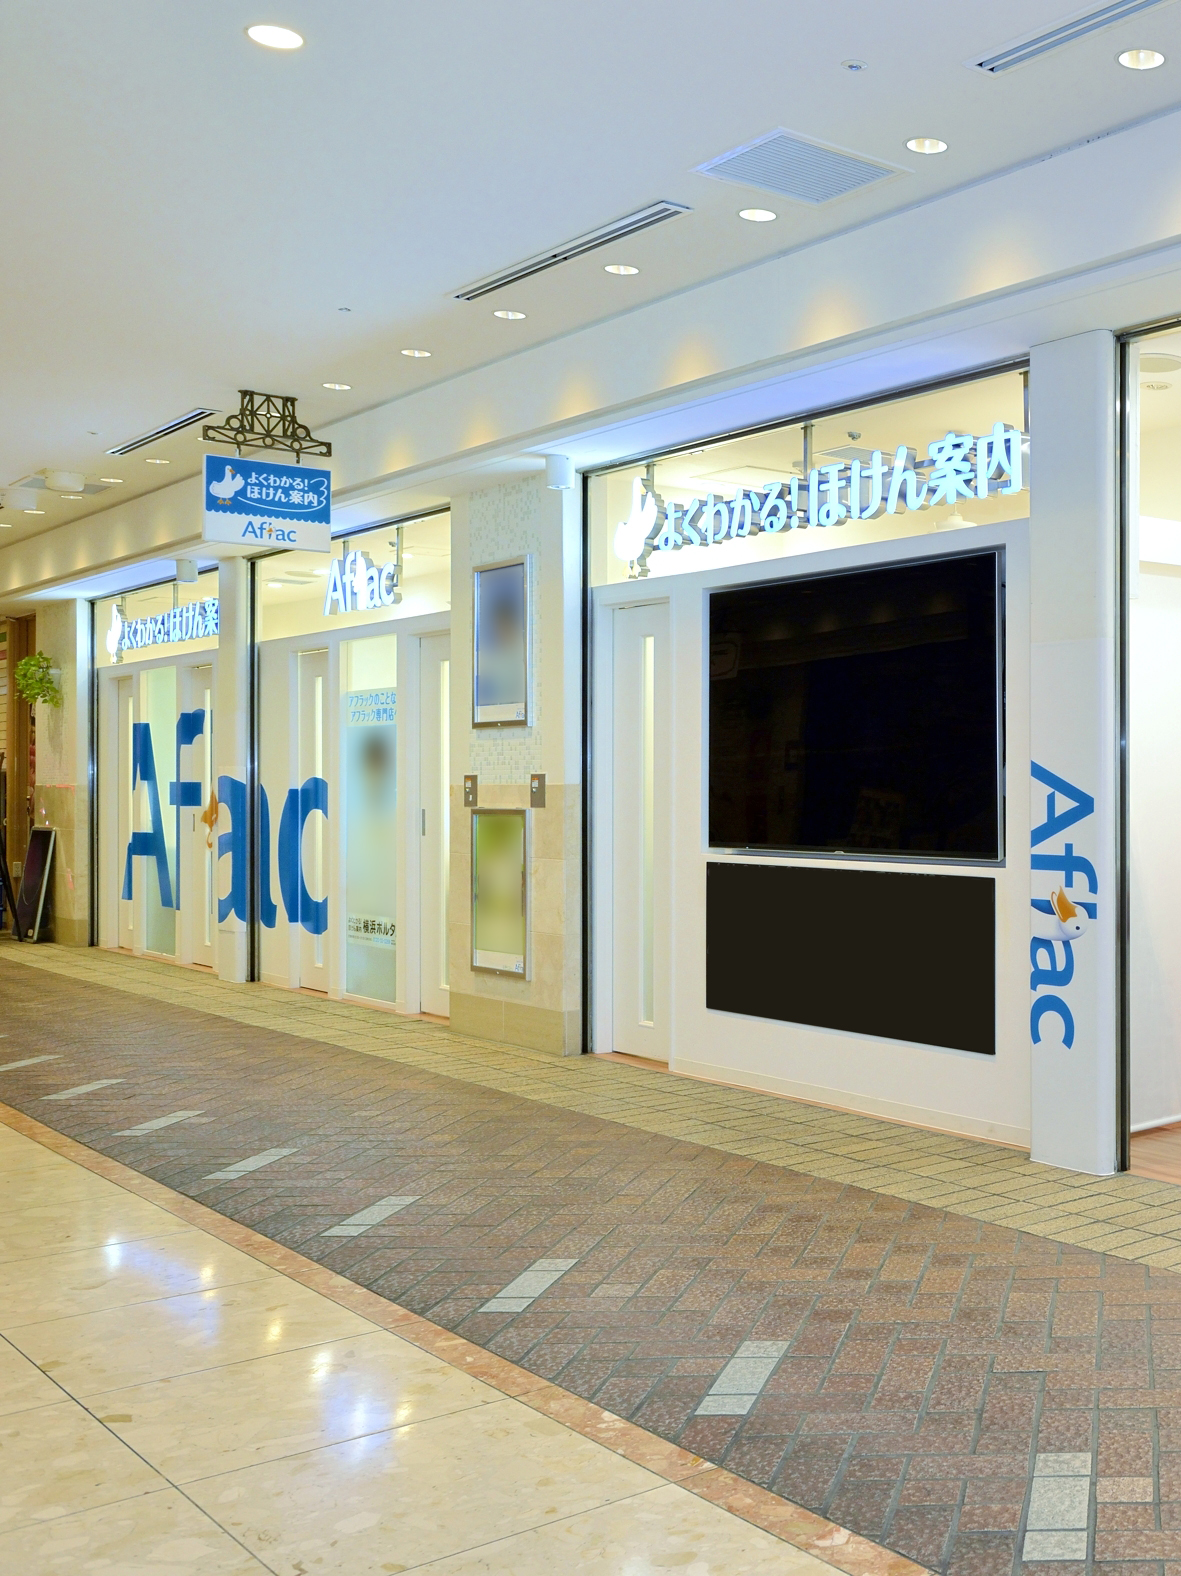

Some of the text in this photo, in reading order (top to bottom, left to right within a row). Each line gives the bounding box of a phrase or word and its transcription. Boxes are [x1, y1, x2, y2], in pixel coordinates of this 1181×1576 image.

[247, 472, 309, 490] よくわかる!
[658, 421, 1024, 552] よくわかる!ほけん案内
[246, 485, 318, 507] ほけん案内
[241, 521, 297, 542] Aflac
[1030, 760, 1098, 1050] Aflac
